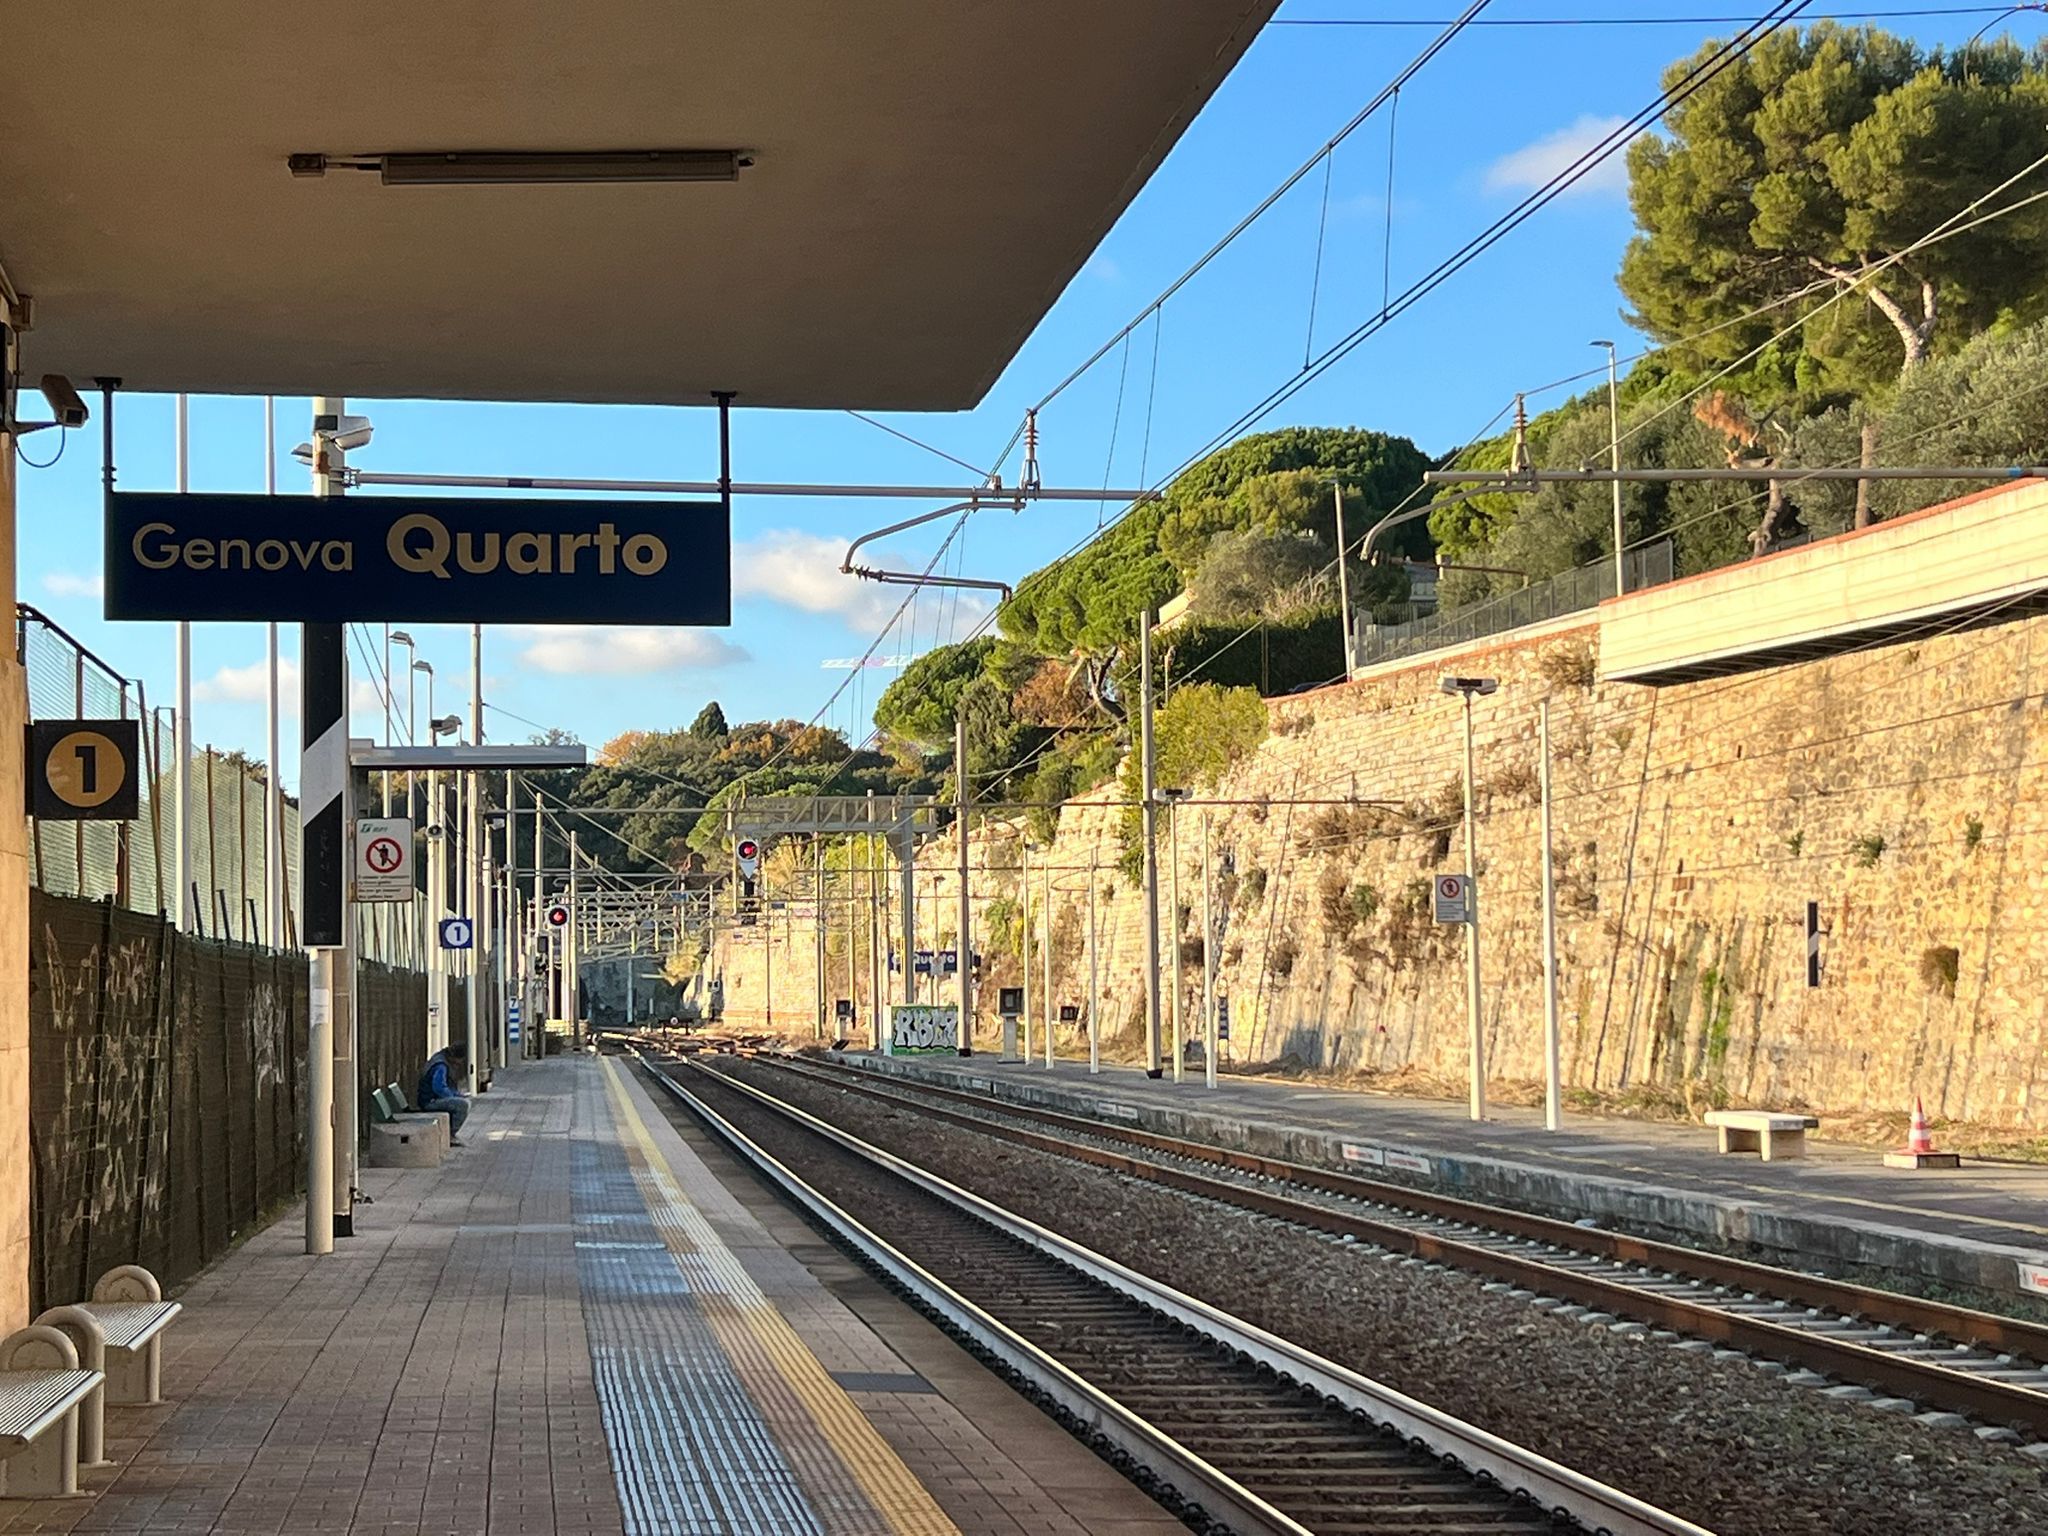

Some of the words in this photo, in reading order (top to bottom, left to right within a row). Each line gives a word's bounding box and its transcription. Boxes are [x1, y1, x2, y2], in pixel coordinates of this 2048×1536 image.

[131, 522, 353, 572] Genova
[386, 513, 668, 579] Quarto
[75, 745, 96, 793] 1
[454, 926, 461, 941] 1
[510, 998, 517, 1007] 7
